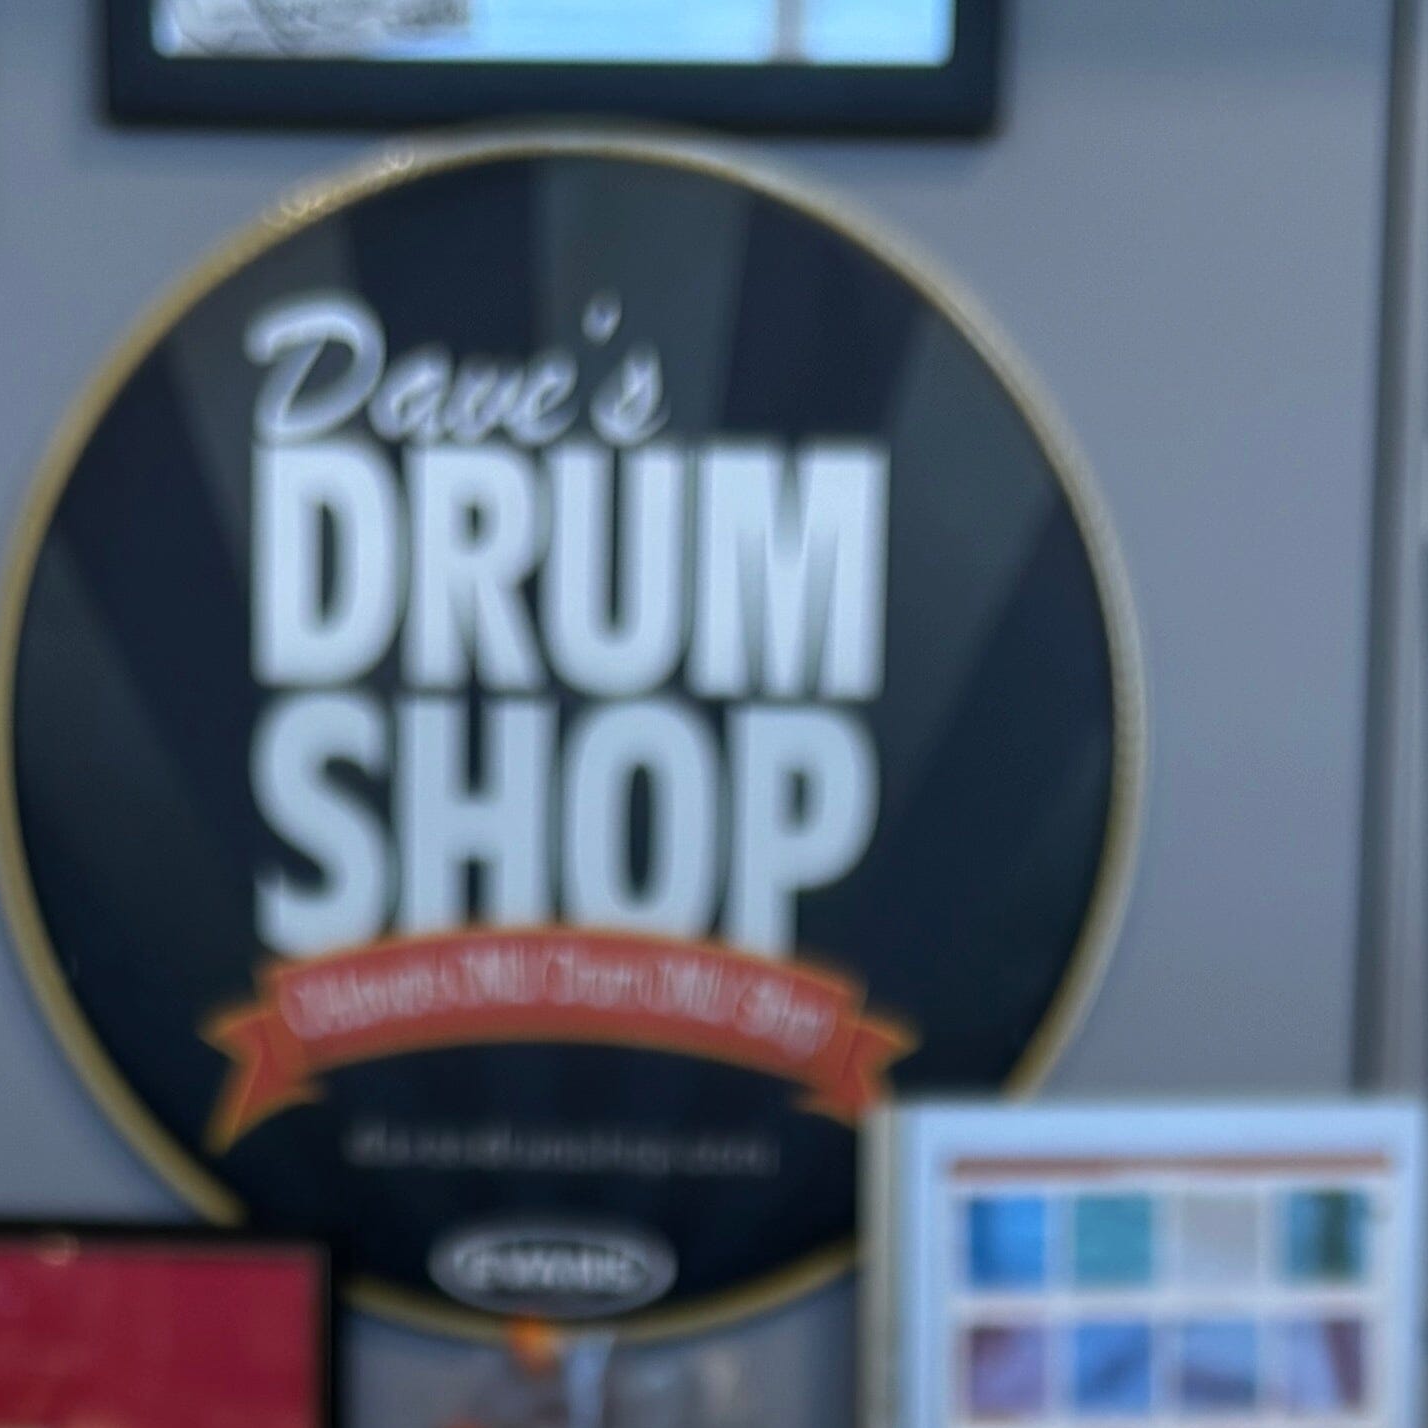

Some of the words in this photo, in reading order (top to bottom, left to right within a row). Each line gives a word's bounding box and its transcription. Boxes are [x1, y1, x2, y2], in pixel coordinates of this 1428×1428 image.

[246, 291, 670, 446] Dave's
[252, 441, 888, 699] DRUM
[251, 693, 879, 956] SHOP
